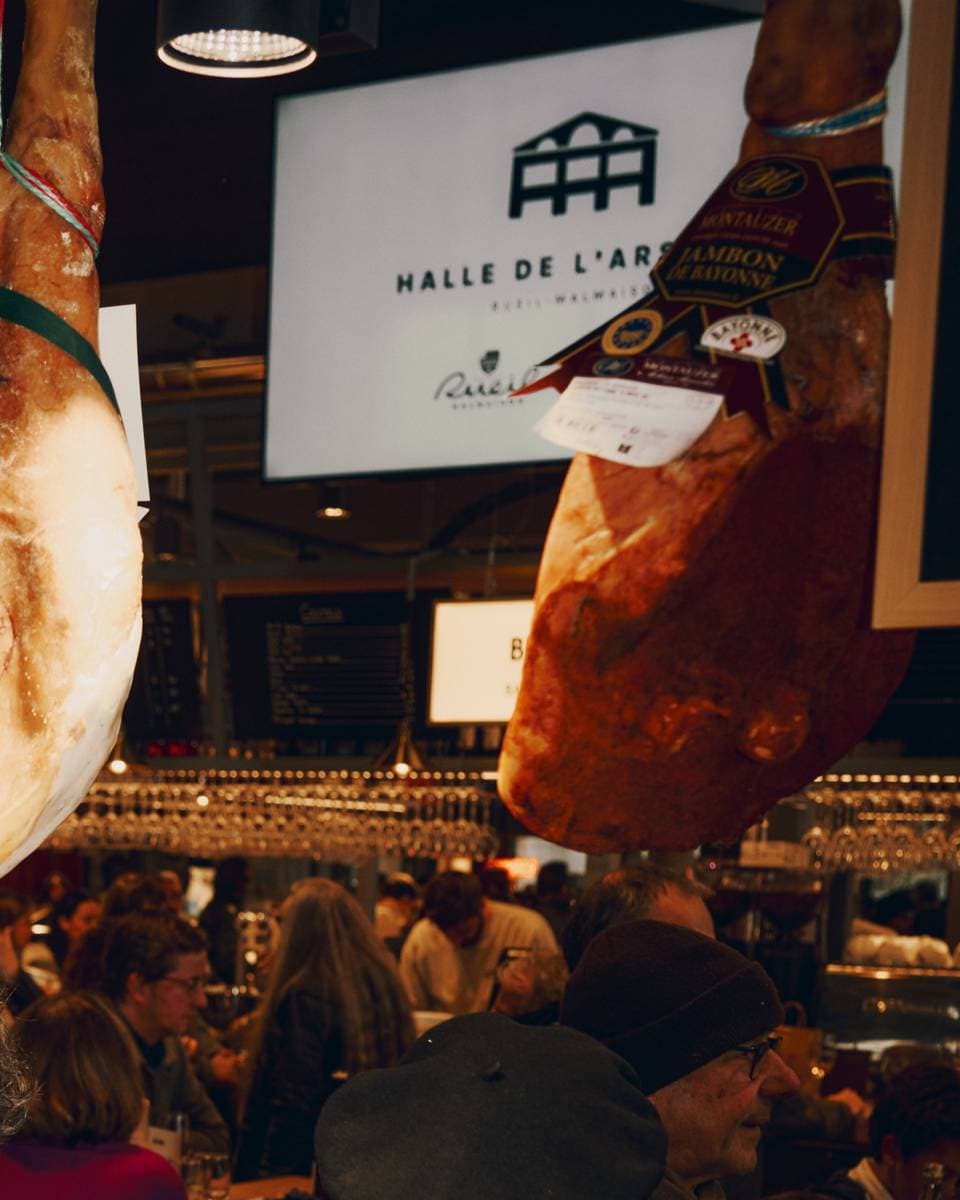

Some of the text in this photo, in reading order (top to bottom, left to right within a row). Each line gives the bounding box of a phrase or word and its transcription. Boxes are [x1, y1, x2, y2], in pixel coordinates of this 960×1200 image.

[676, 246, 785, 272] JAMBON
[397, 263, 496, 293] HALLE
[514, 256, 553, 280] DE
[690, 265, 778, 290] BAYONNE
